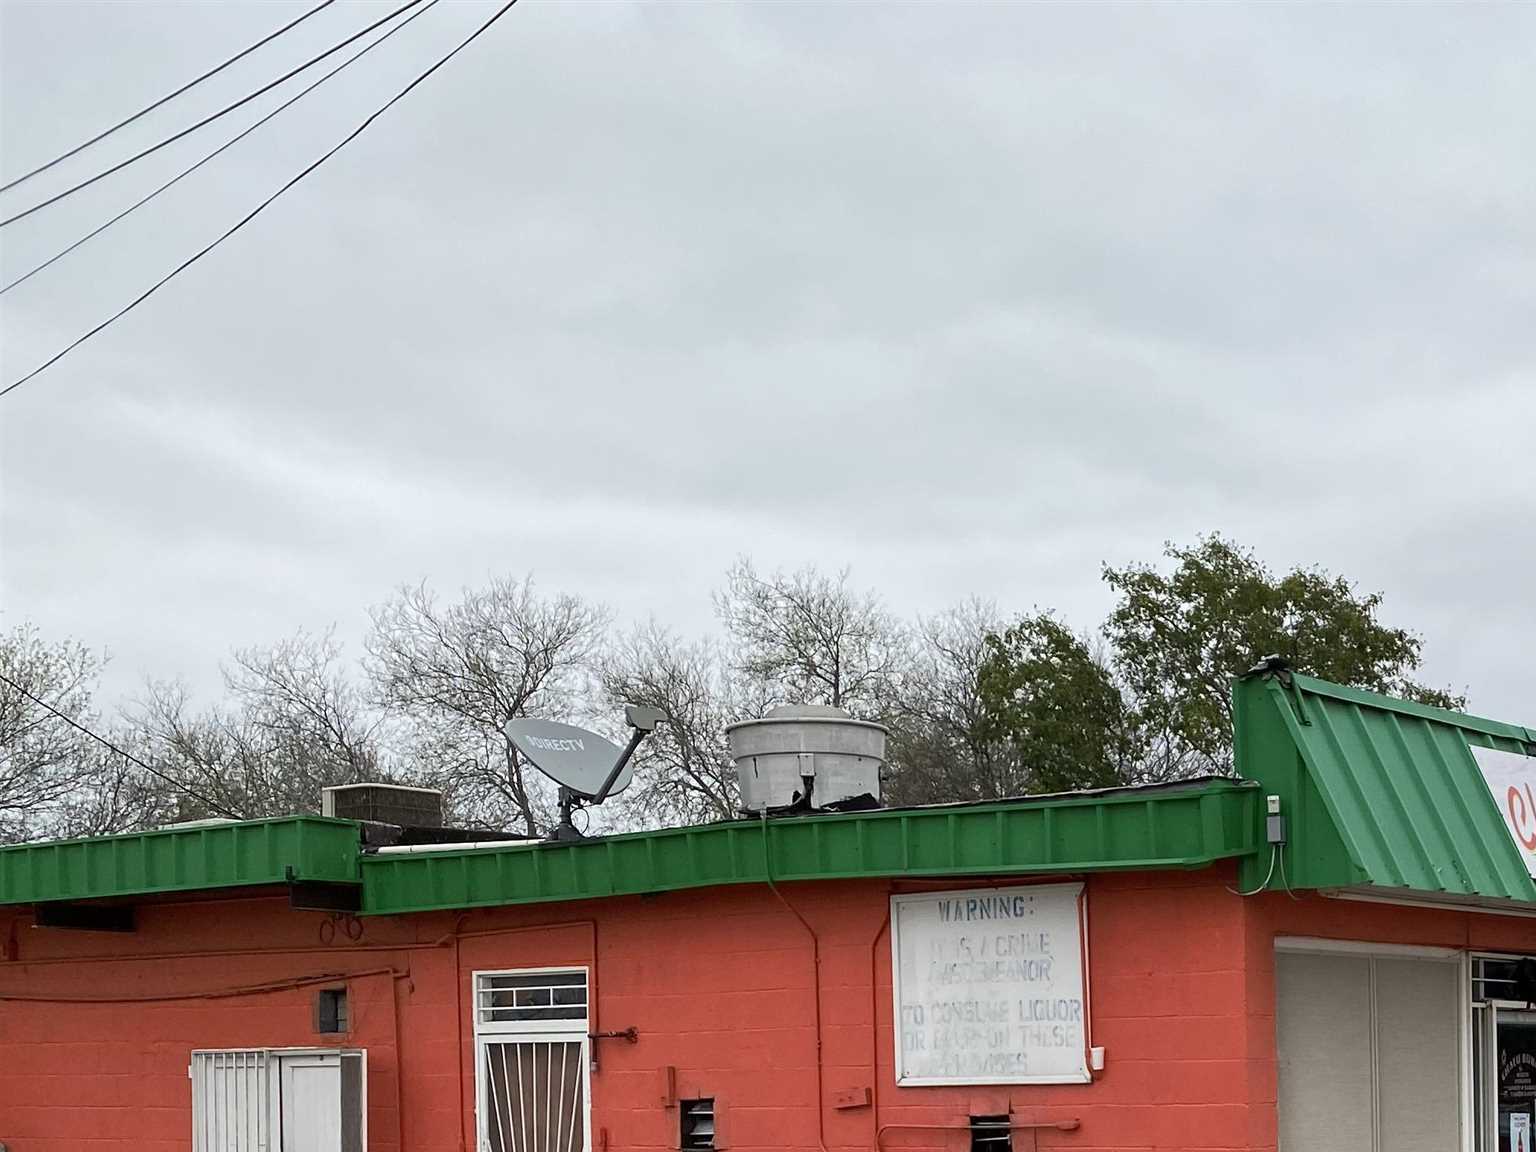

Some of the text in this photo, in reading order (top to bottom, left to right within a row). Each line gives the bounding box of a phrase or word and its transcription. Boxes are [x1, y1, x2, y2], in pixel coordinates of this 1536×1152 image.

[534, 737, 584, 751] DIRECTV
[938, 896, 1034, 922] WARNING:
[902, 1002, 925, 1026] TO
